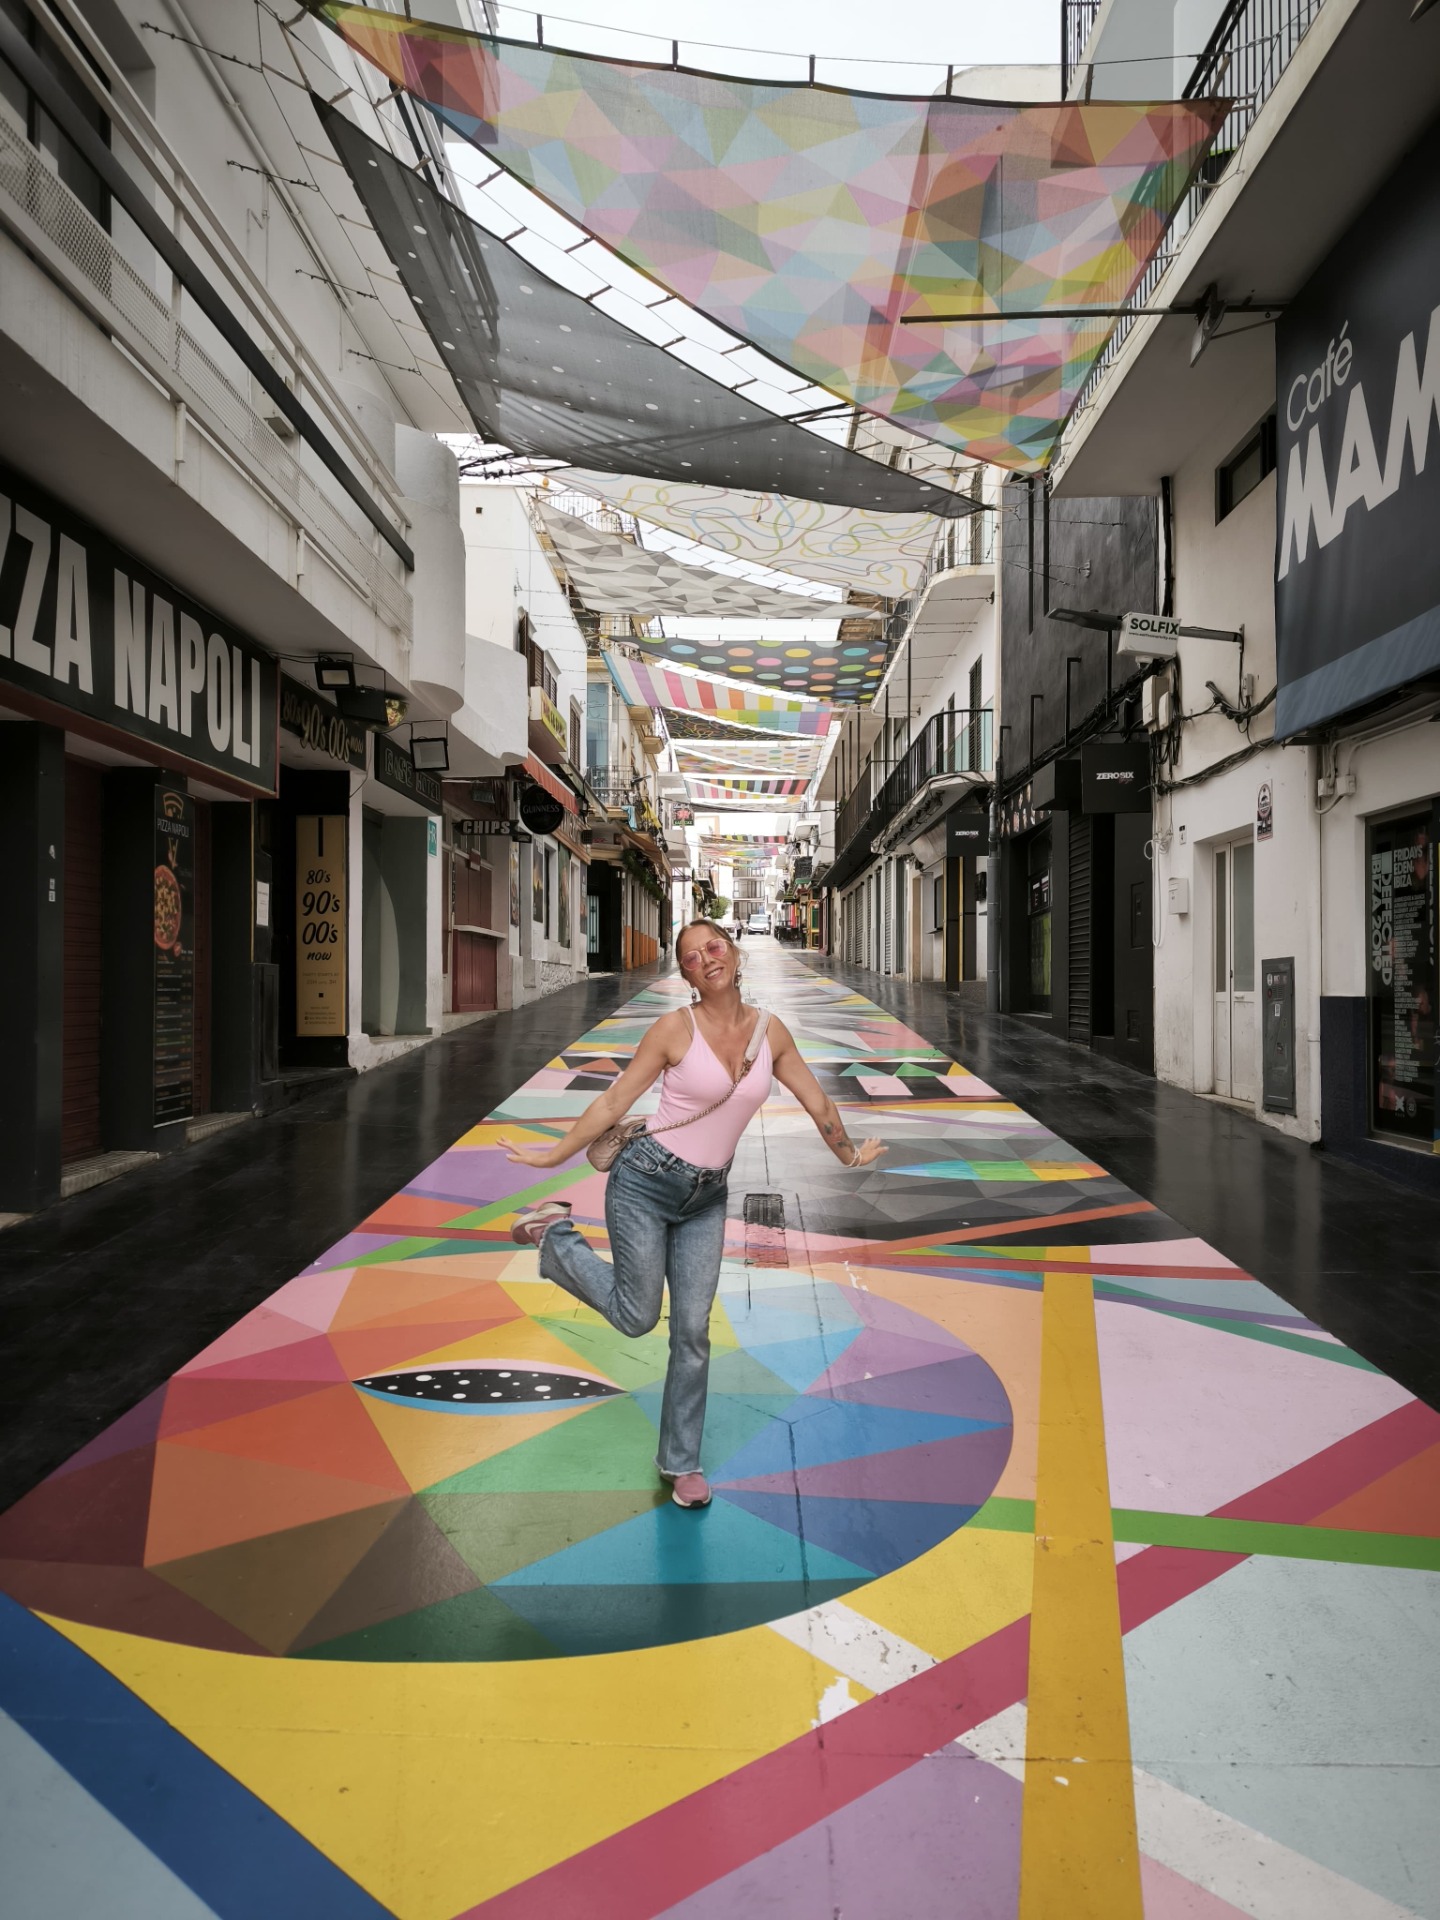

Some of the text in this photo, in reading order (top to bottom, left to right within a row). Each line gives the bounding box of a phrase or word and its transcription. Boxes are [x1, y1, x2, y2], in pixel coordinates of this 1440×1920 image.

[1287, 319, 1353, 432] Café
[1130, 618, 1179, 635] SOLFIX
[114, 567, 261, 769] NAPOLI
[299, 700, 326, 751] 90's
[328, 715, 351, 764] 00's
[523, 803, 560, 815] GUINNESS
[157, 817, 190, 838] PIZZA NAPOLI
[463, 821, 511, 835] CHIPS
[1394, 845, 1423, 862] FRIDAYS
[306, 869, 331, 885] 80's
[1394, 874, 1413, 888] IBIZA
[303, 890, 341, 916] 90's
[1372, 854, 1382, 972] IBIZA 2019
[303, 921, 339, 945] 00's
[1382, 873, 1392, 986] DEFECTED
[307, 951, 332, 962] now
